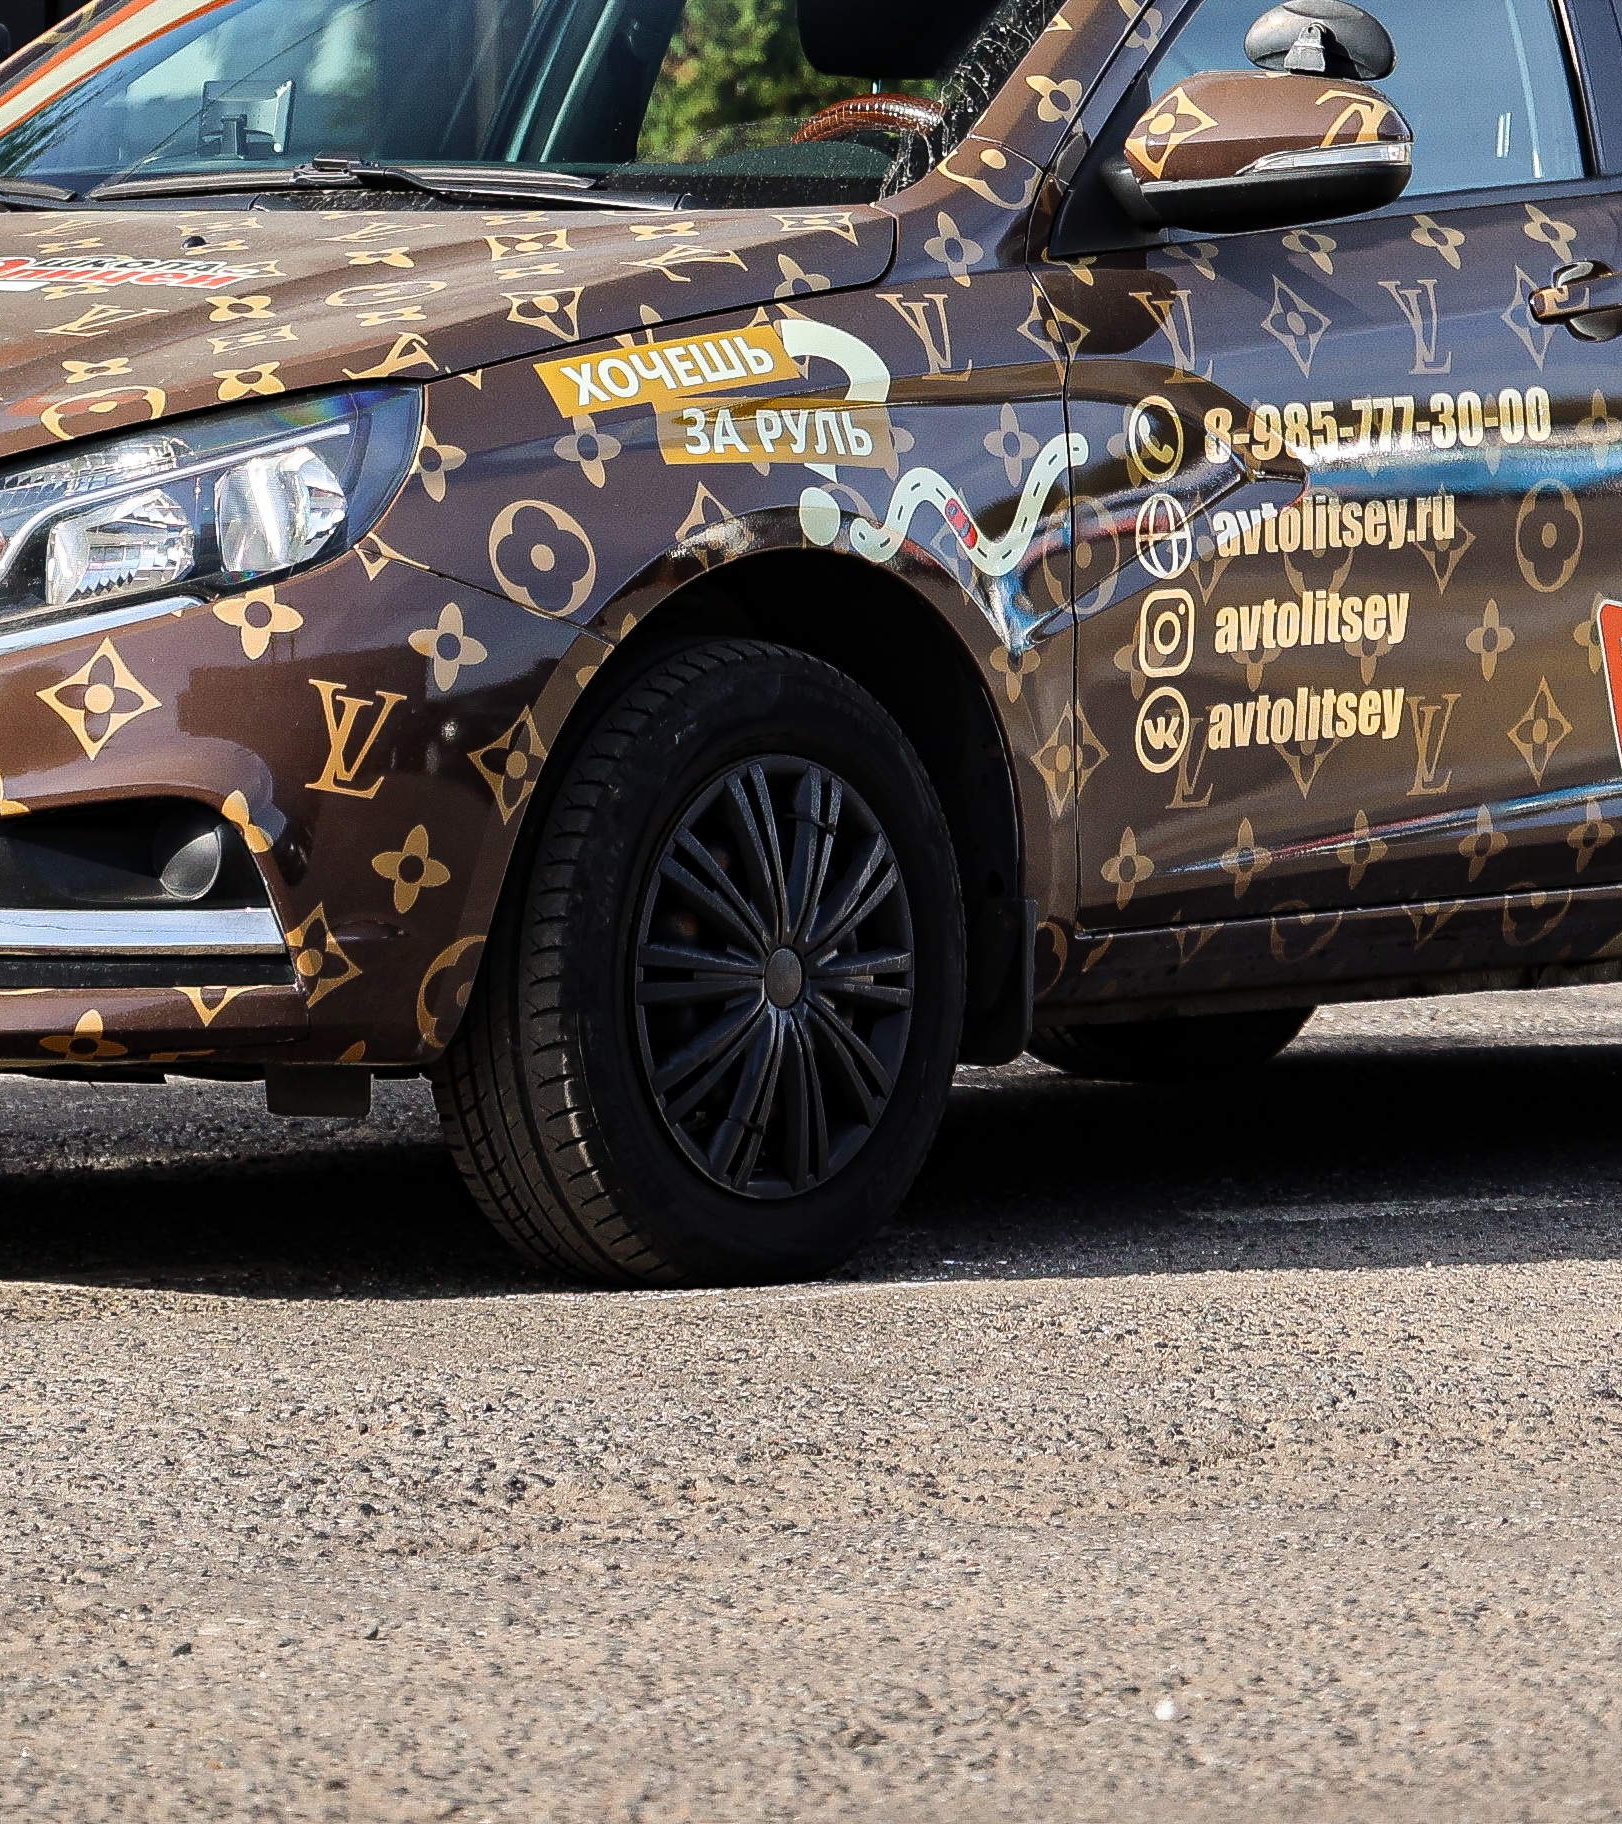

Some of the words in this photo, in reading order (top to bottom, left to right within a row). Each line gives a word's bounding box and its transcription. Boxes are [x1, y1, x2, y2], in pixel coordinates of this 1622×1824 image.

[560, 335, 775, 407] ХОЧЕШЬ
[682, 407, 750, 455] ЗА
[756, 407, 874, 458] РУЛЬ
[1204, 386, 1551, 465] 8-985-777-30-00
[1213, 493, 1456, 558] avtolitsey.ru
[1215, 589, 1411, 654] avtolitsey
[1208, 686, 1406, 751] avtolitsey
